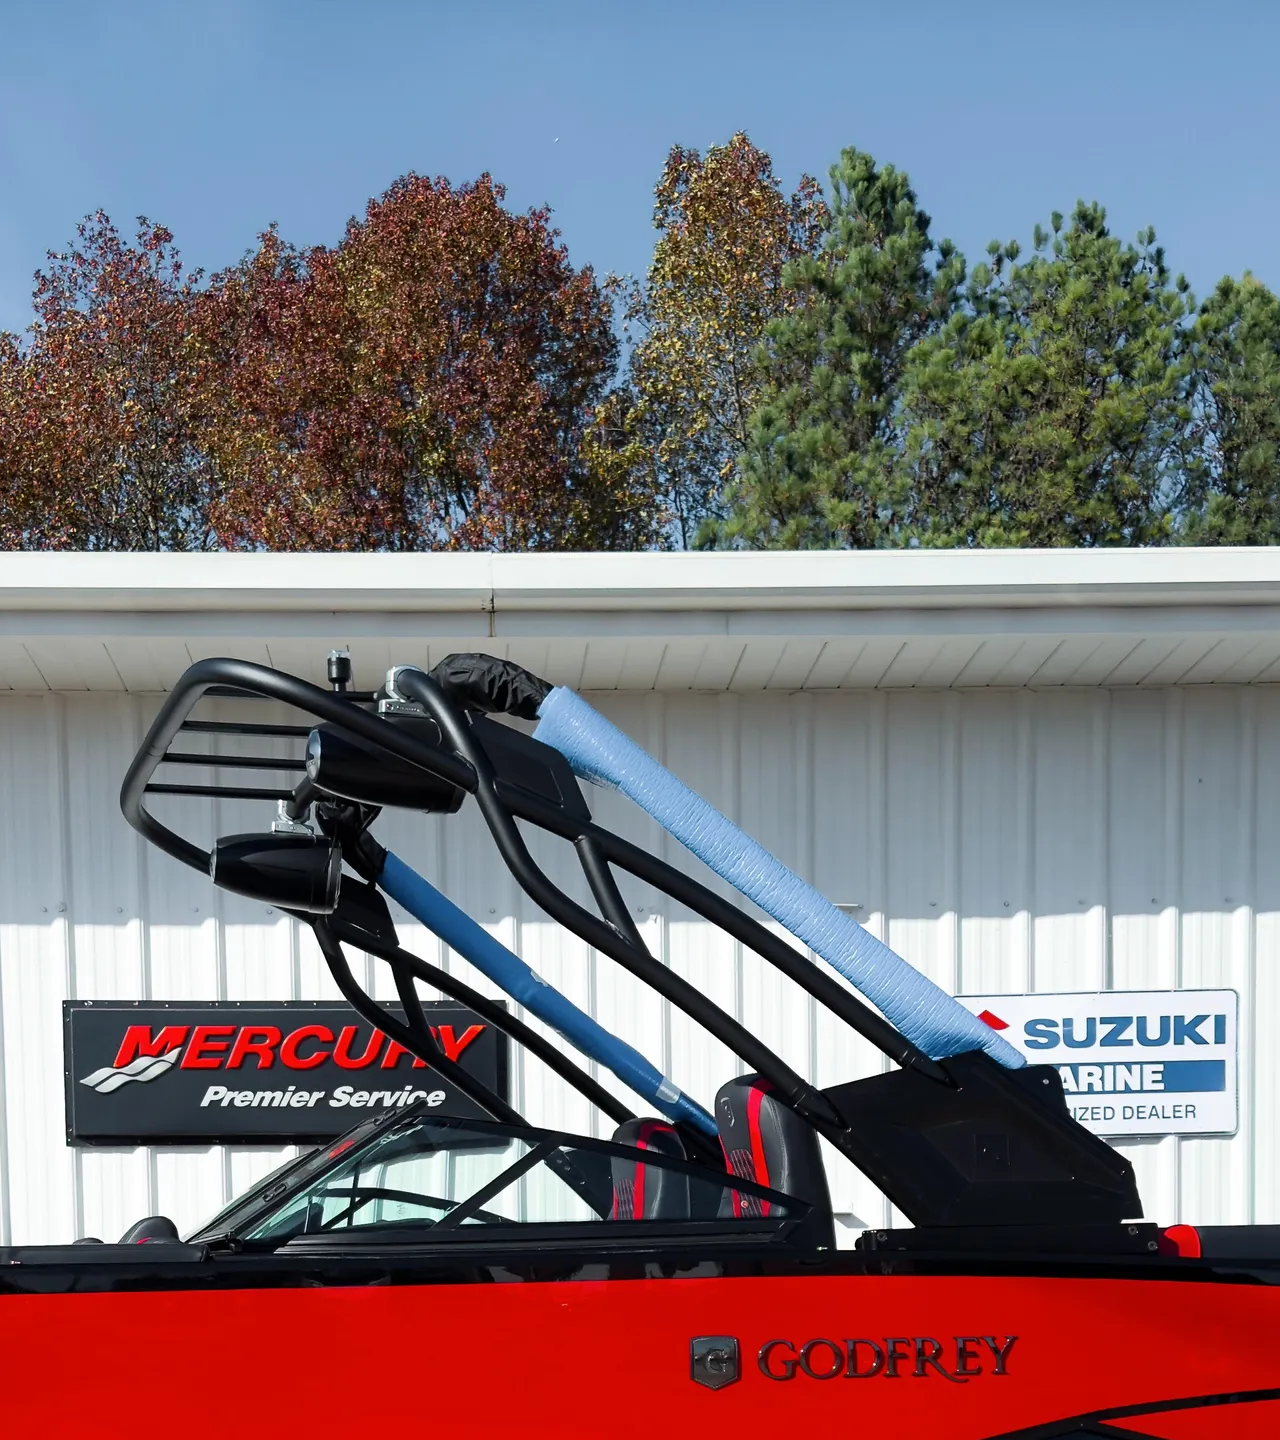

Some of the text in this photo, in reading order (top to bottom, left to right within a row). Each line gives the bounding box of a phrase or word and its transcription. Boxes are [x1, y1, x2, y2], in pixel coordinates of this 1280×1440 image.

[1024, 1014, 1226, 1049] SUZUKI
[1058, 1064, 1165, 1092] ARINE
[200, 1084, 447, 1108] Premier Service
[1122, 1104, 1197, 1120] DEALER
[757, 1335, 1019, 1384] GODFREY
